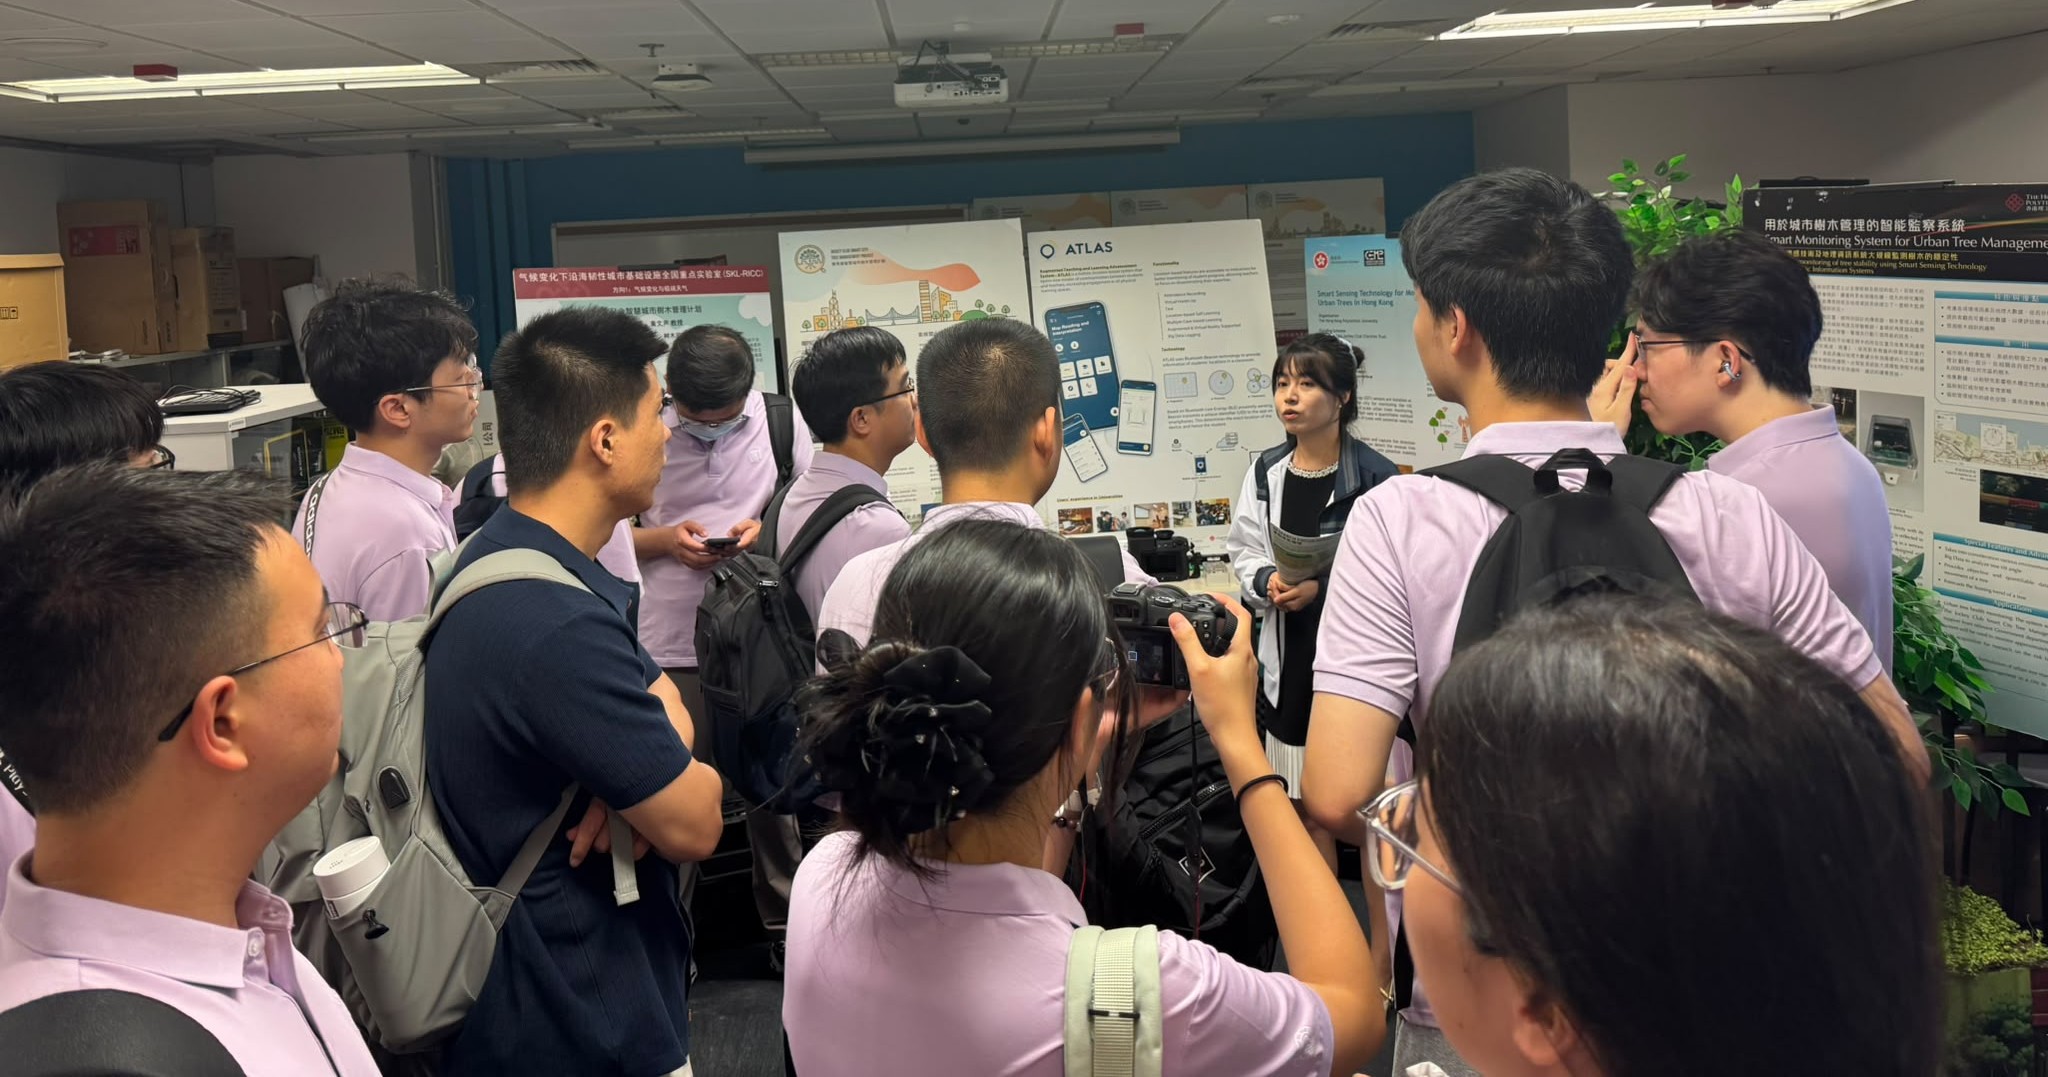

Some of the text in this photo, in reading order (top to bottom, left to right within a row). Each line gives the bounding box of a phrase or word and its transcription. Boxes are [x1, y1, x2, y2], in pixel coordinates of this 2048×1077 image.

[1764, 218, 1966, 232] 用於城市樹木管理的智能監察系統
[1065, 241, 1113, 256] ATLAS
[1794, 234, 1851, 249] Monitoring
[1854, 234, 1892, 248] System
[1895, 234, 1910, 247] for
[1913, 235, 1950, 247] Urban
[1951, 236, 1978, 248] Tree
[1919, 262, 1946, 271] Sensing
[1947, 262, 1988, 272] Technology
[1335, 290, 1358, 298] Sensing
[1359, 289, 1393, 298] Technology
[1361, 299, 1377, 307] Hong
[1378, 299, 1394, 307] Kong
[1964, 538, 1986, 548] Special
[1987, 542, 2014, 553] Features
[2015, 547, 2027, 555] and
